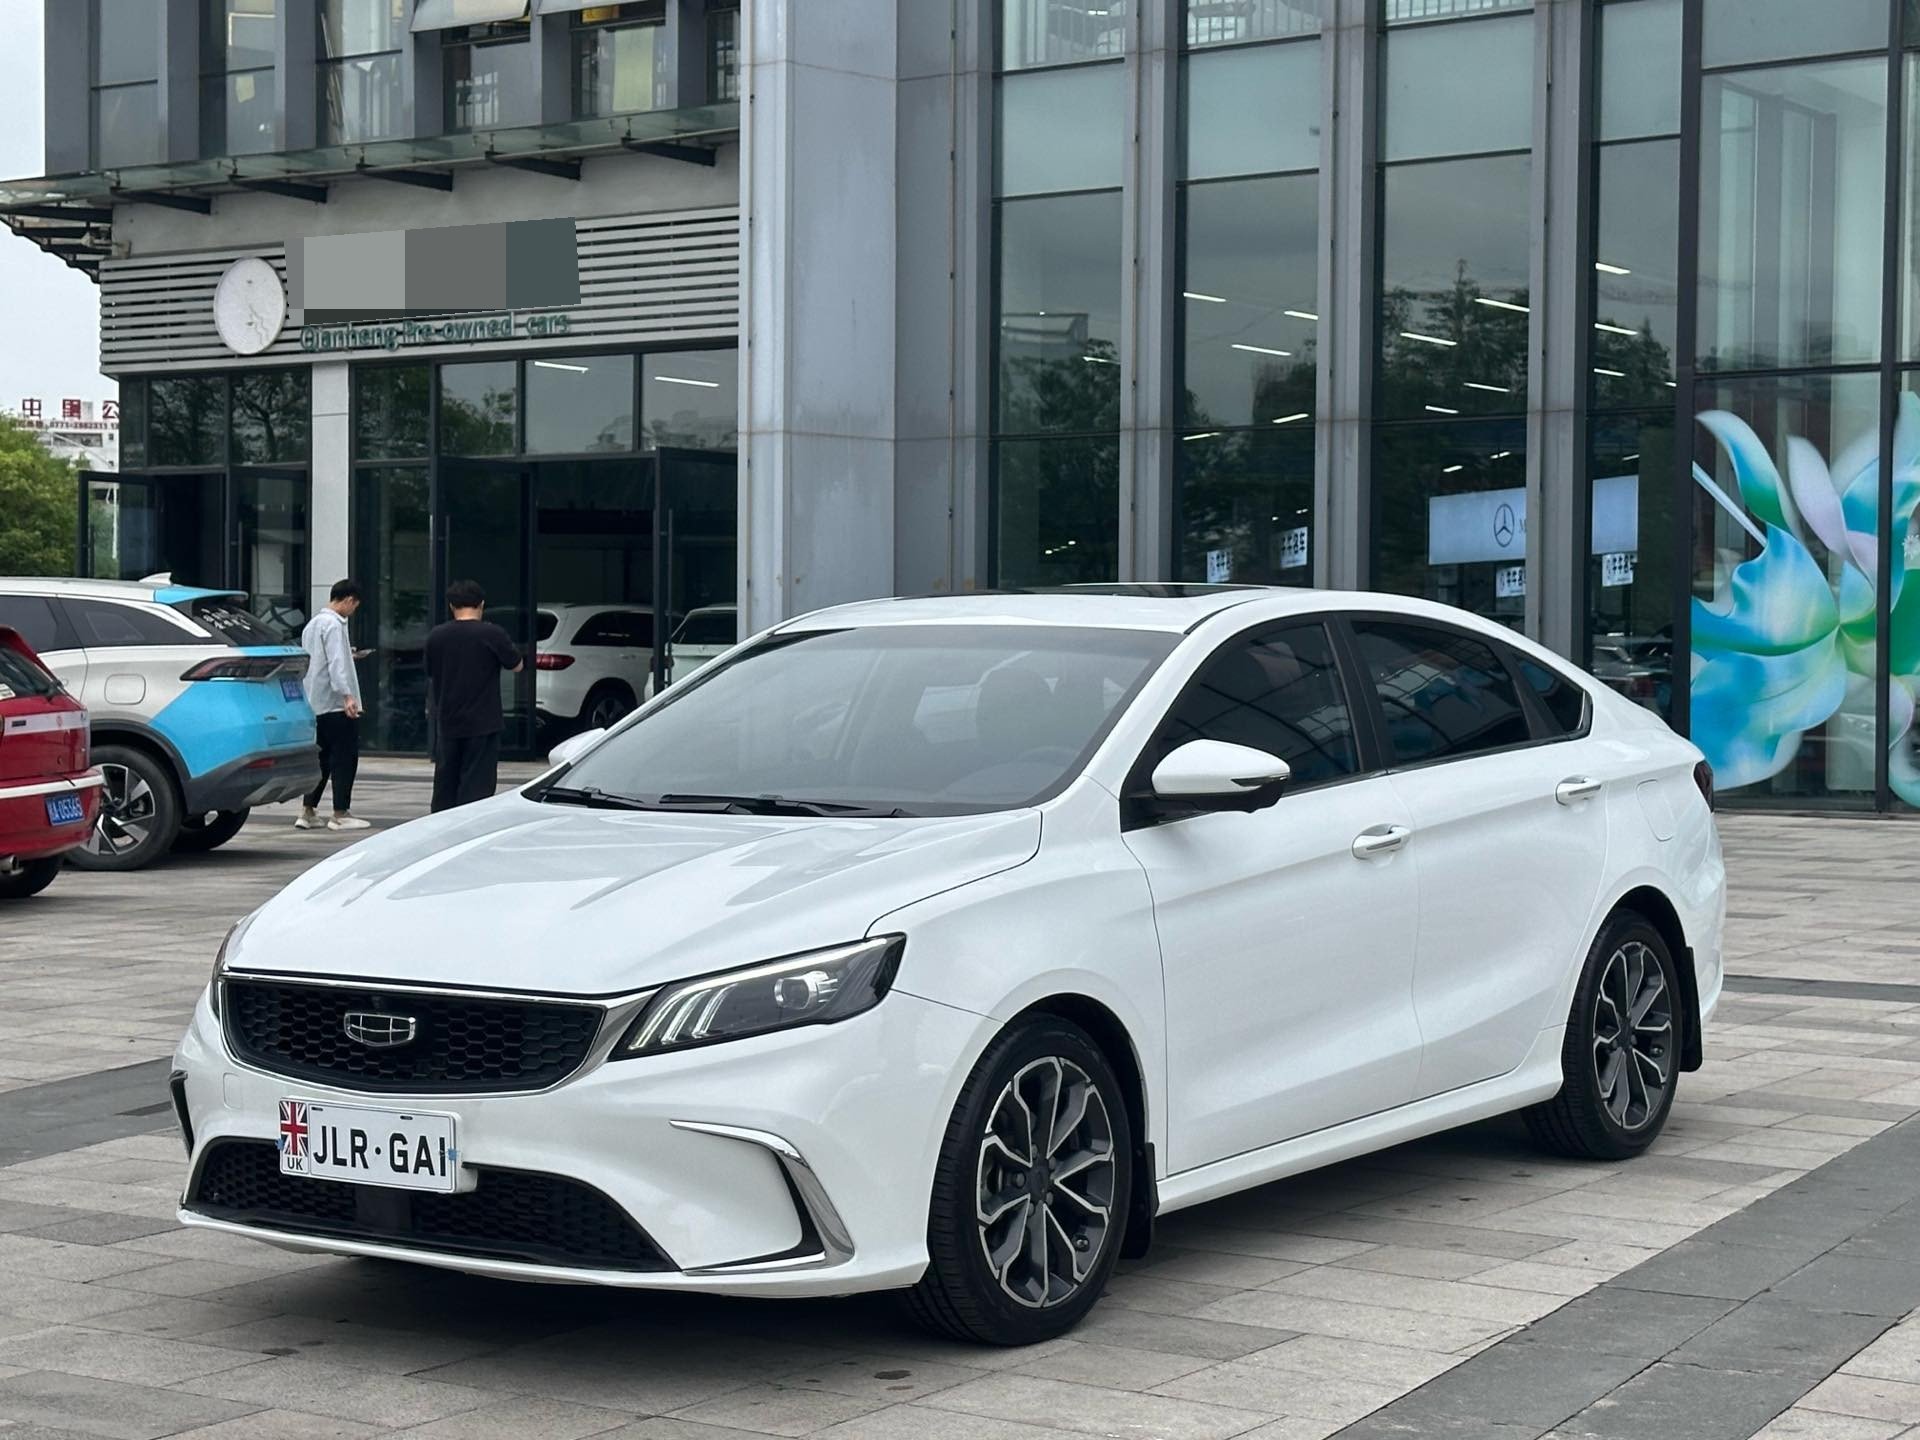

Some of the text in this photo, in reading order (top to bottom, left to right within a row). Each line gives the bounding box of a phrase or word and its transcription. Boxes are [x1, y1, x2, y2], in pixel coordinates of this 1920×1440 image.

[301, 311, 569, 352] Qianheng Pre-owned cars
[287, 1157, 303, 1171] UK
